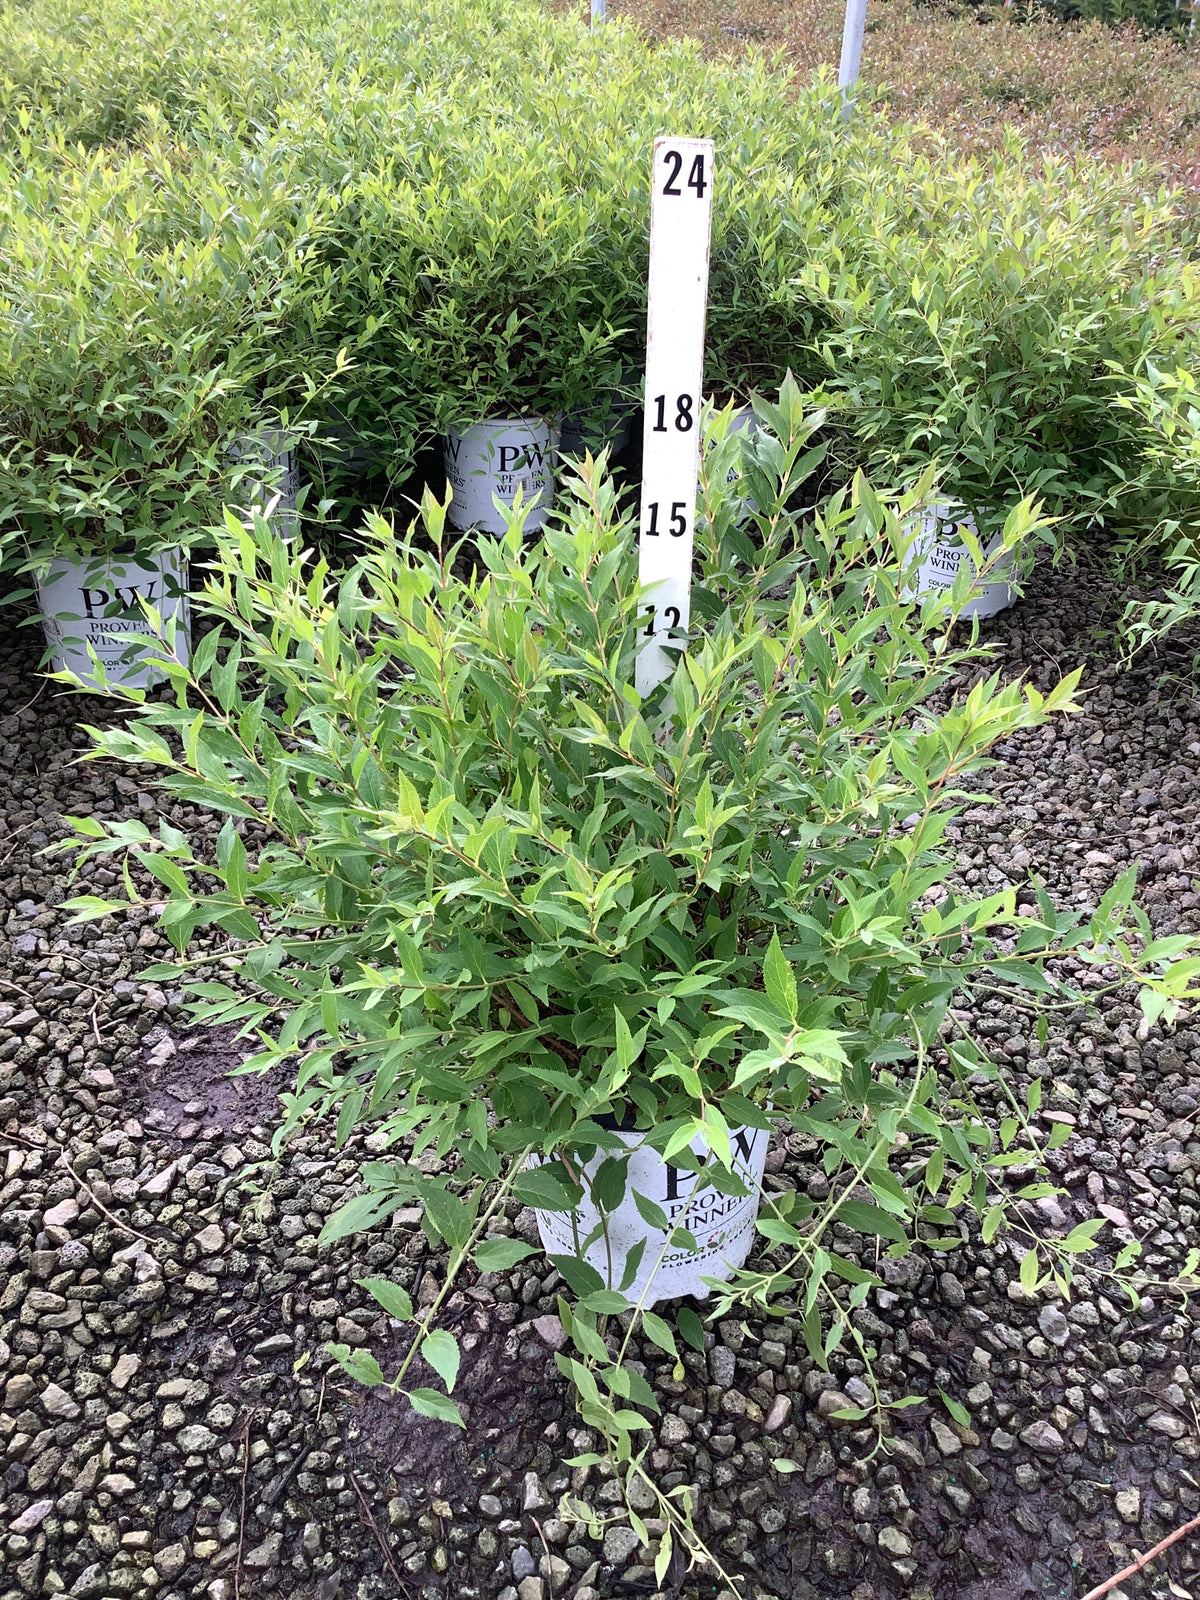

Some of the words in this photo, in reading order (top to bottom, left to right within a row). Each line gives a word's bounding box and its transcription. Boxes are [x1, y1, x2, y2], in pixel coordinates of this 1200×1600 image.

[663, 150, 707, 198] 24
[653, 393, 693, 432] 18
[497, 439, 549, 472] PW
[646, 502, 687, 537] 15
[643, 605, 681, 639] 12
[661, 1246, 705, 1263] COLOR
